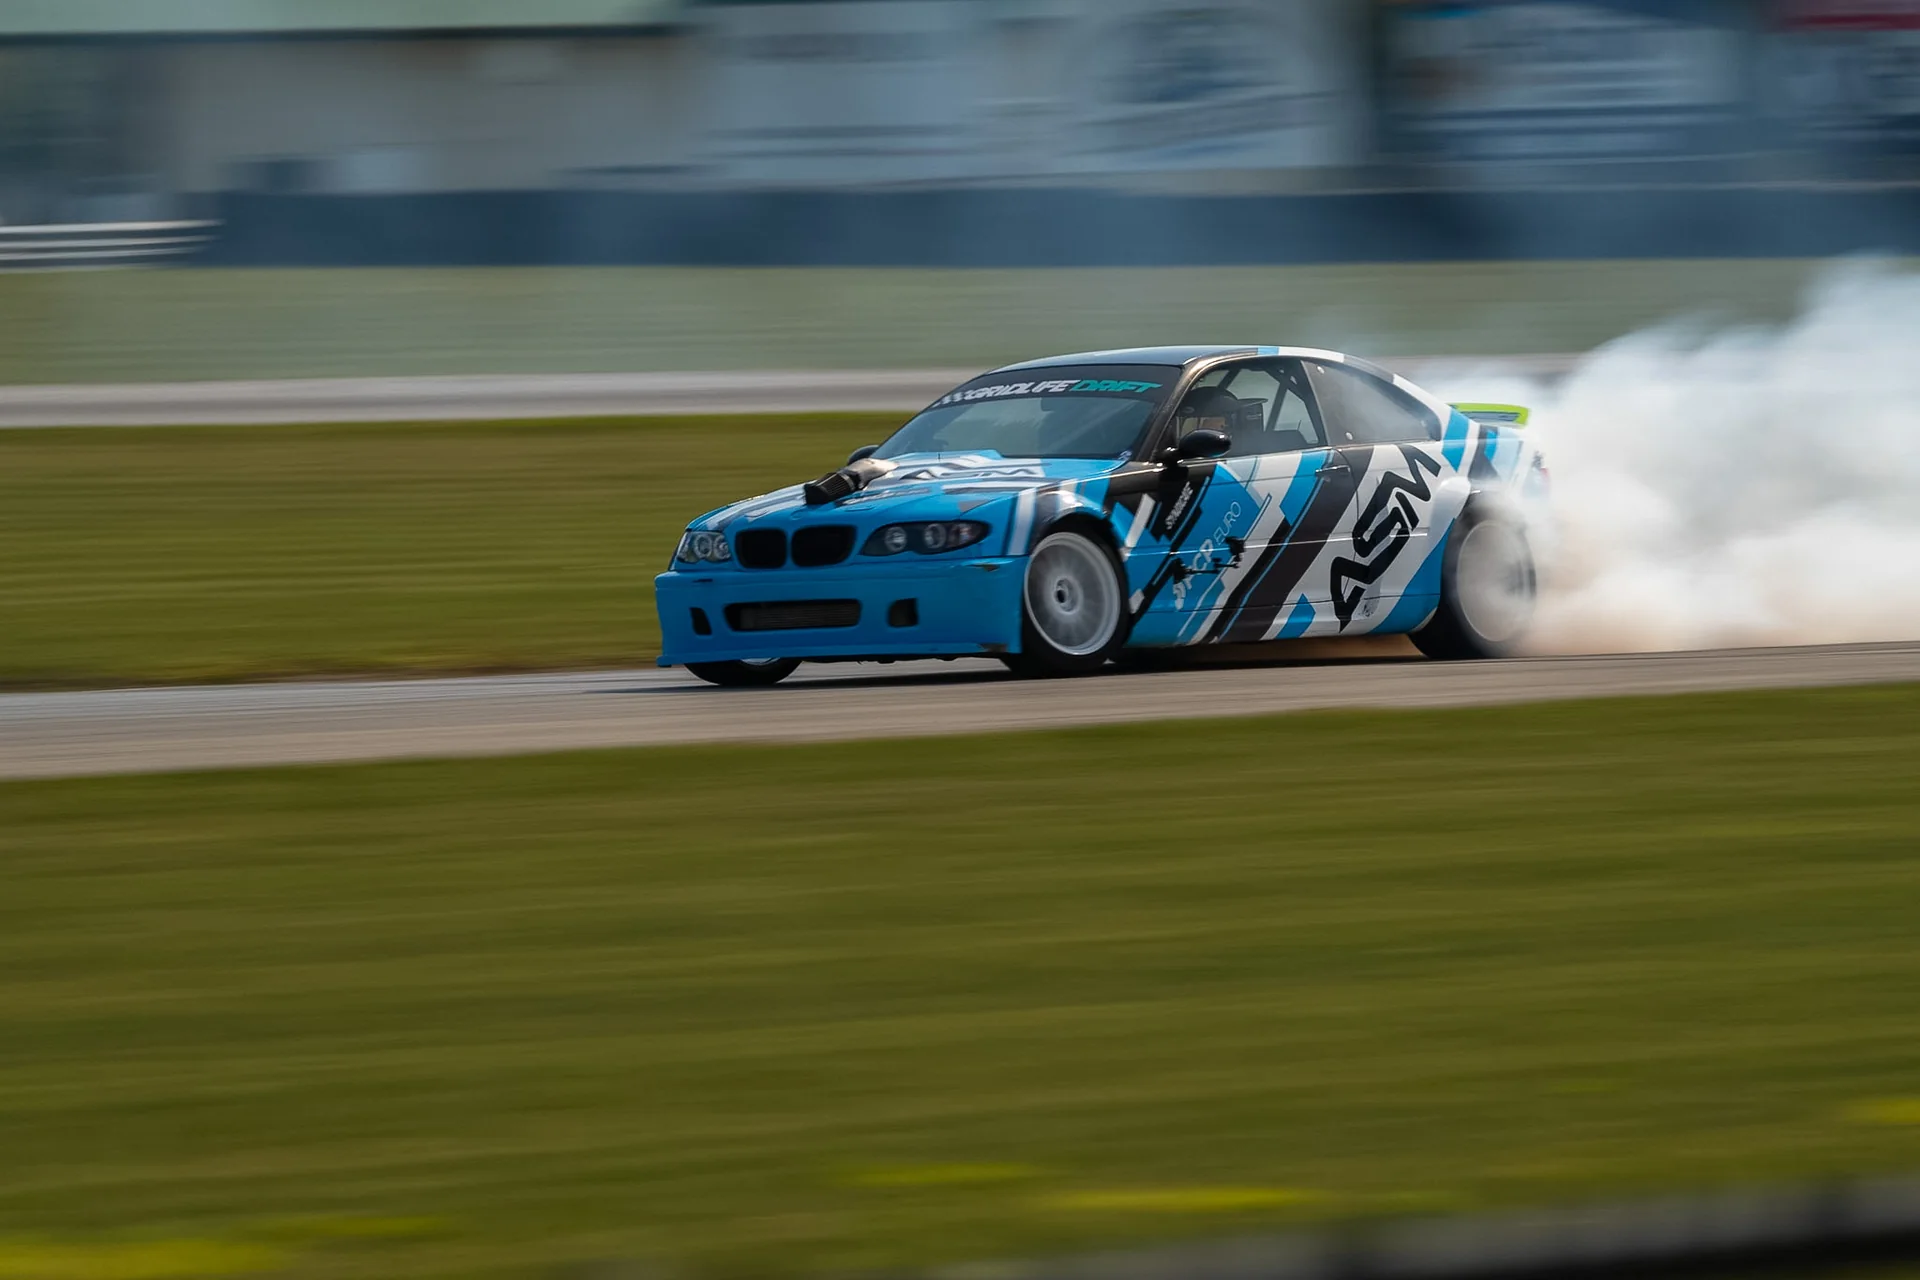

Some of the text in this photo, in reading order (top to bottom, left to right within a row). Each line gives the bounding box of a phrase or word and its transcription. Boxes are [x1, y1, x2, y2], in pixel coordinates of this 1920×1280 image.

[973, 379, 1163, 398] GRIDLIFE DRIFT
[1214, 502, 1241, 545] EURO
[1330, 444, 1441, 633] ASM
